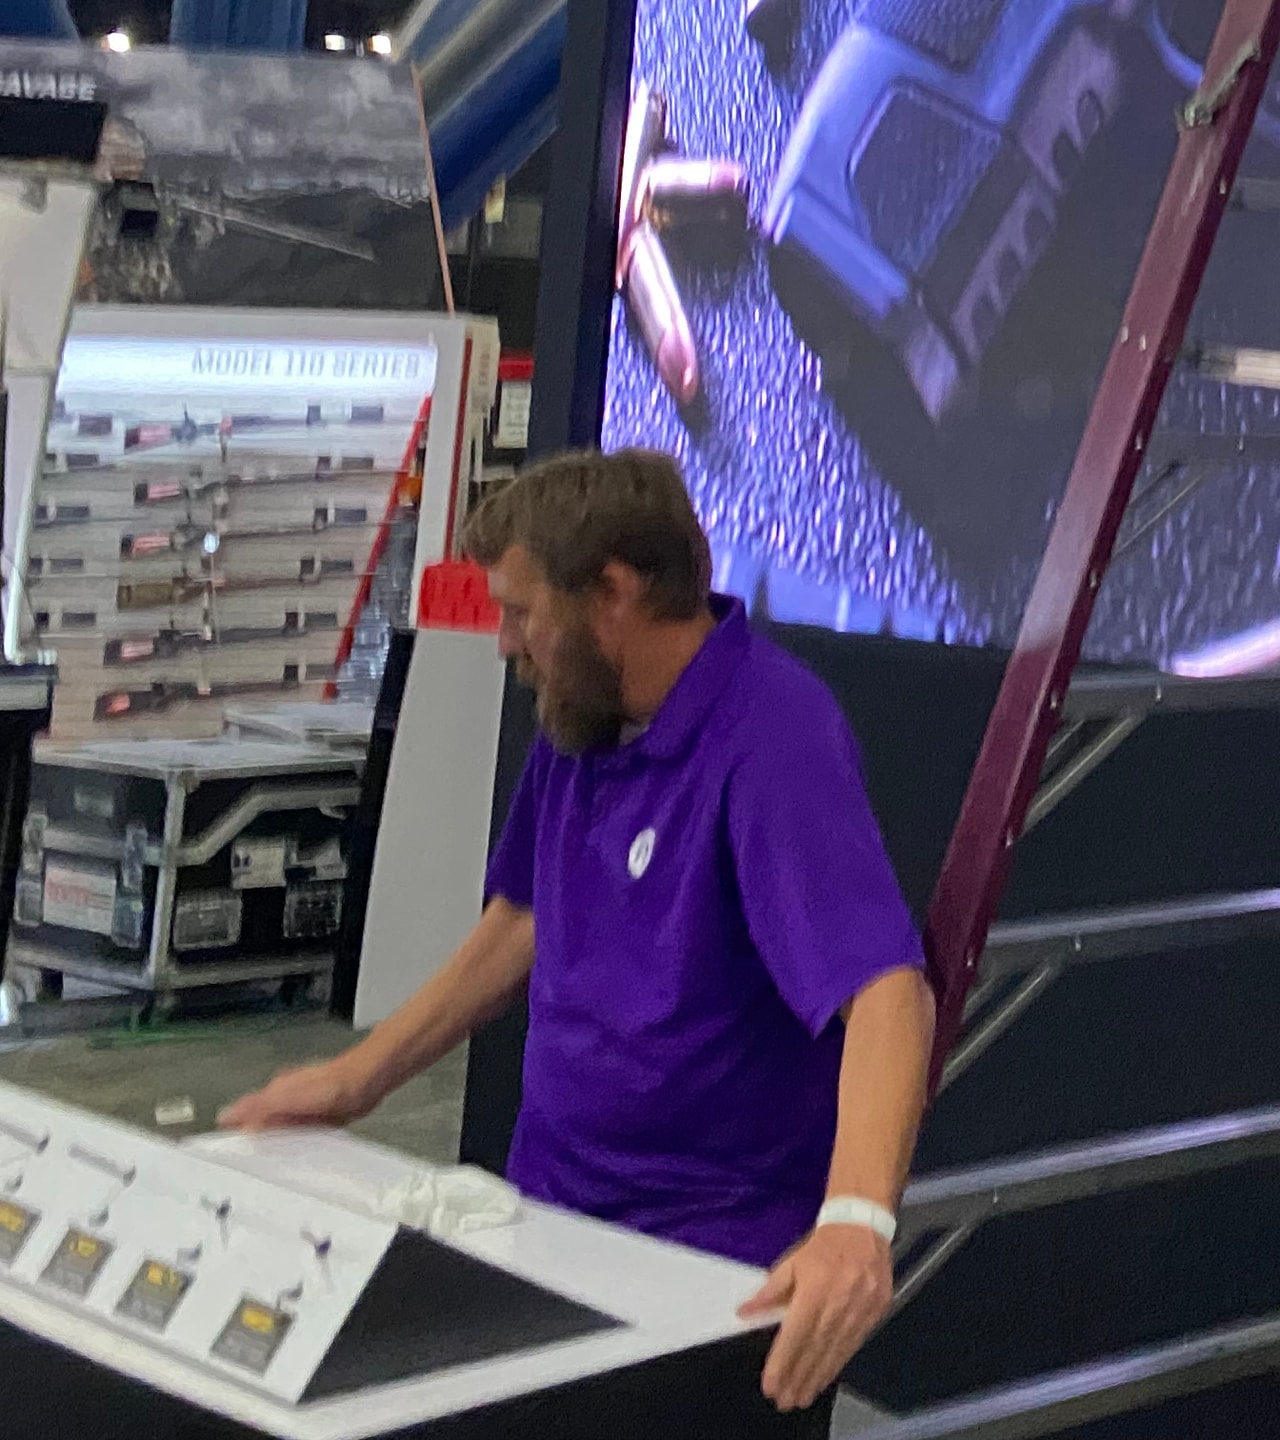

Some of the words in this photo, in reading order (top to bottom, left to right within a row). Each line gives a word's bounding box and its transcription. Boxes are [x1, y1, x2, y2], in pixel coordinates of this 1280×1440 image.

[0, 69, 97, 101] AVAGE
[191, 347, 272, 376] MODEL
[332, 351, 422, 379] SERIES
